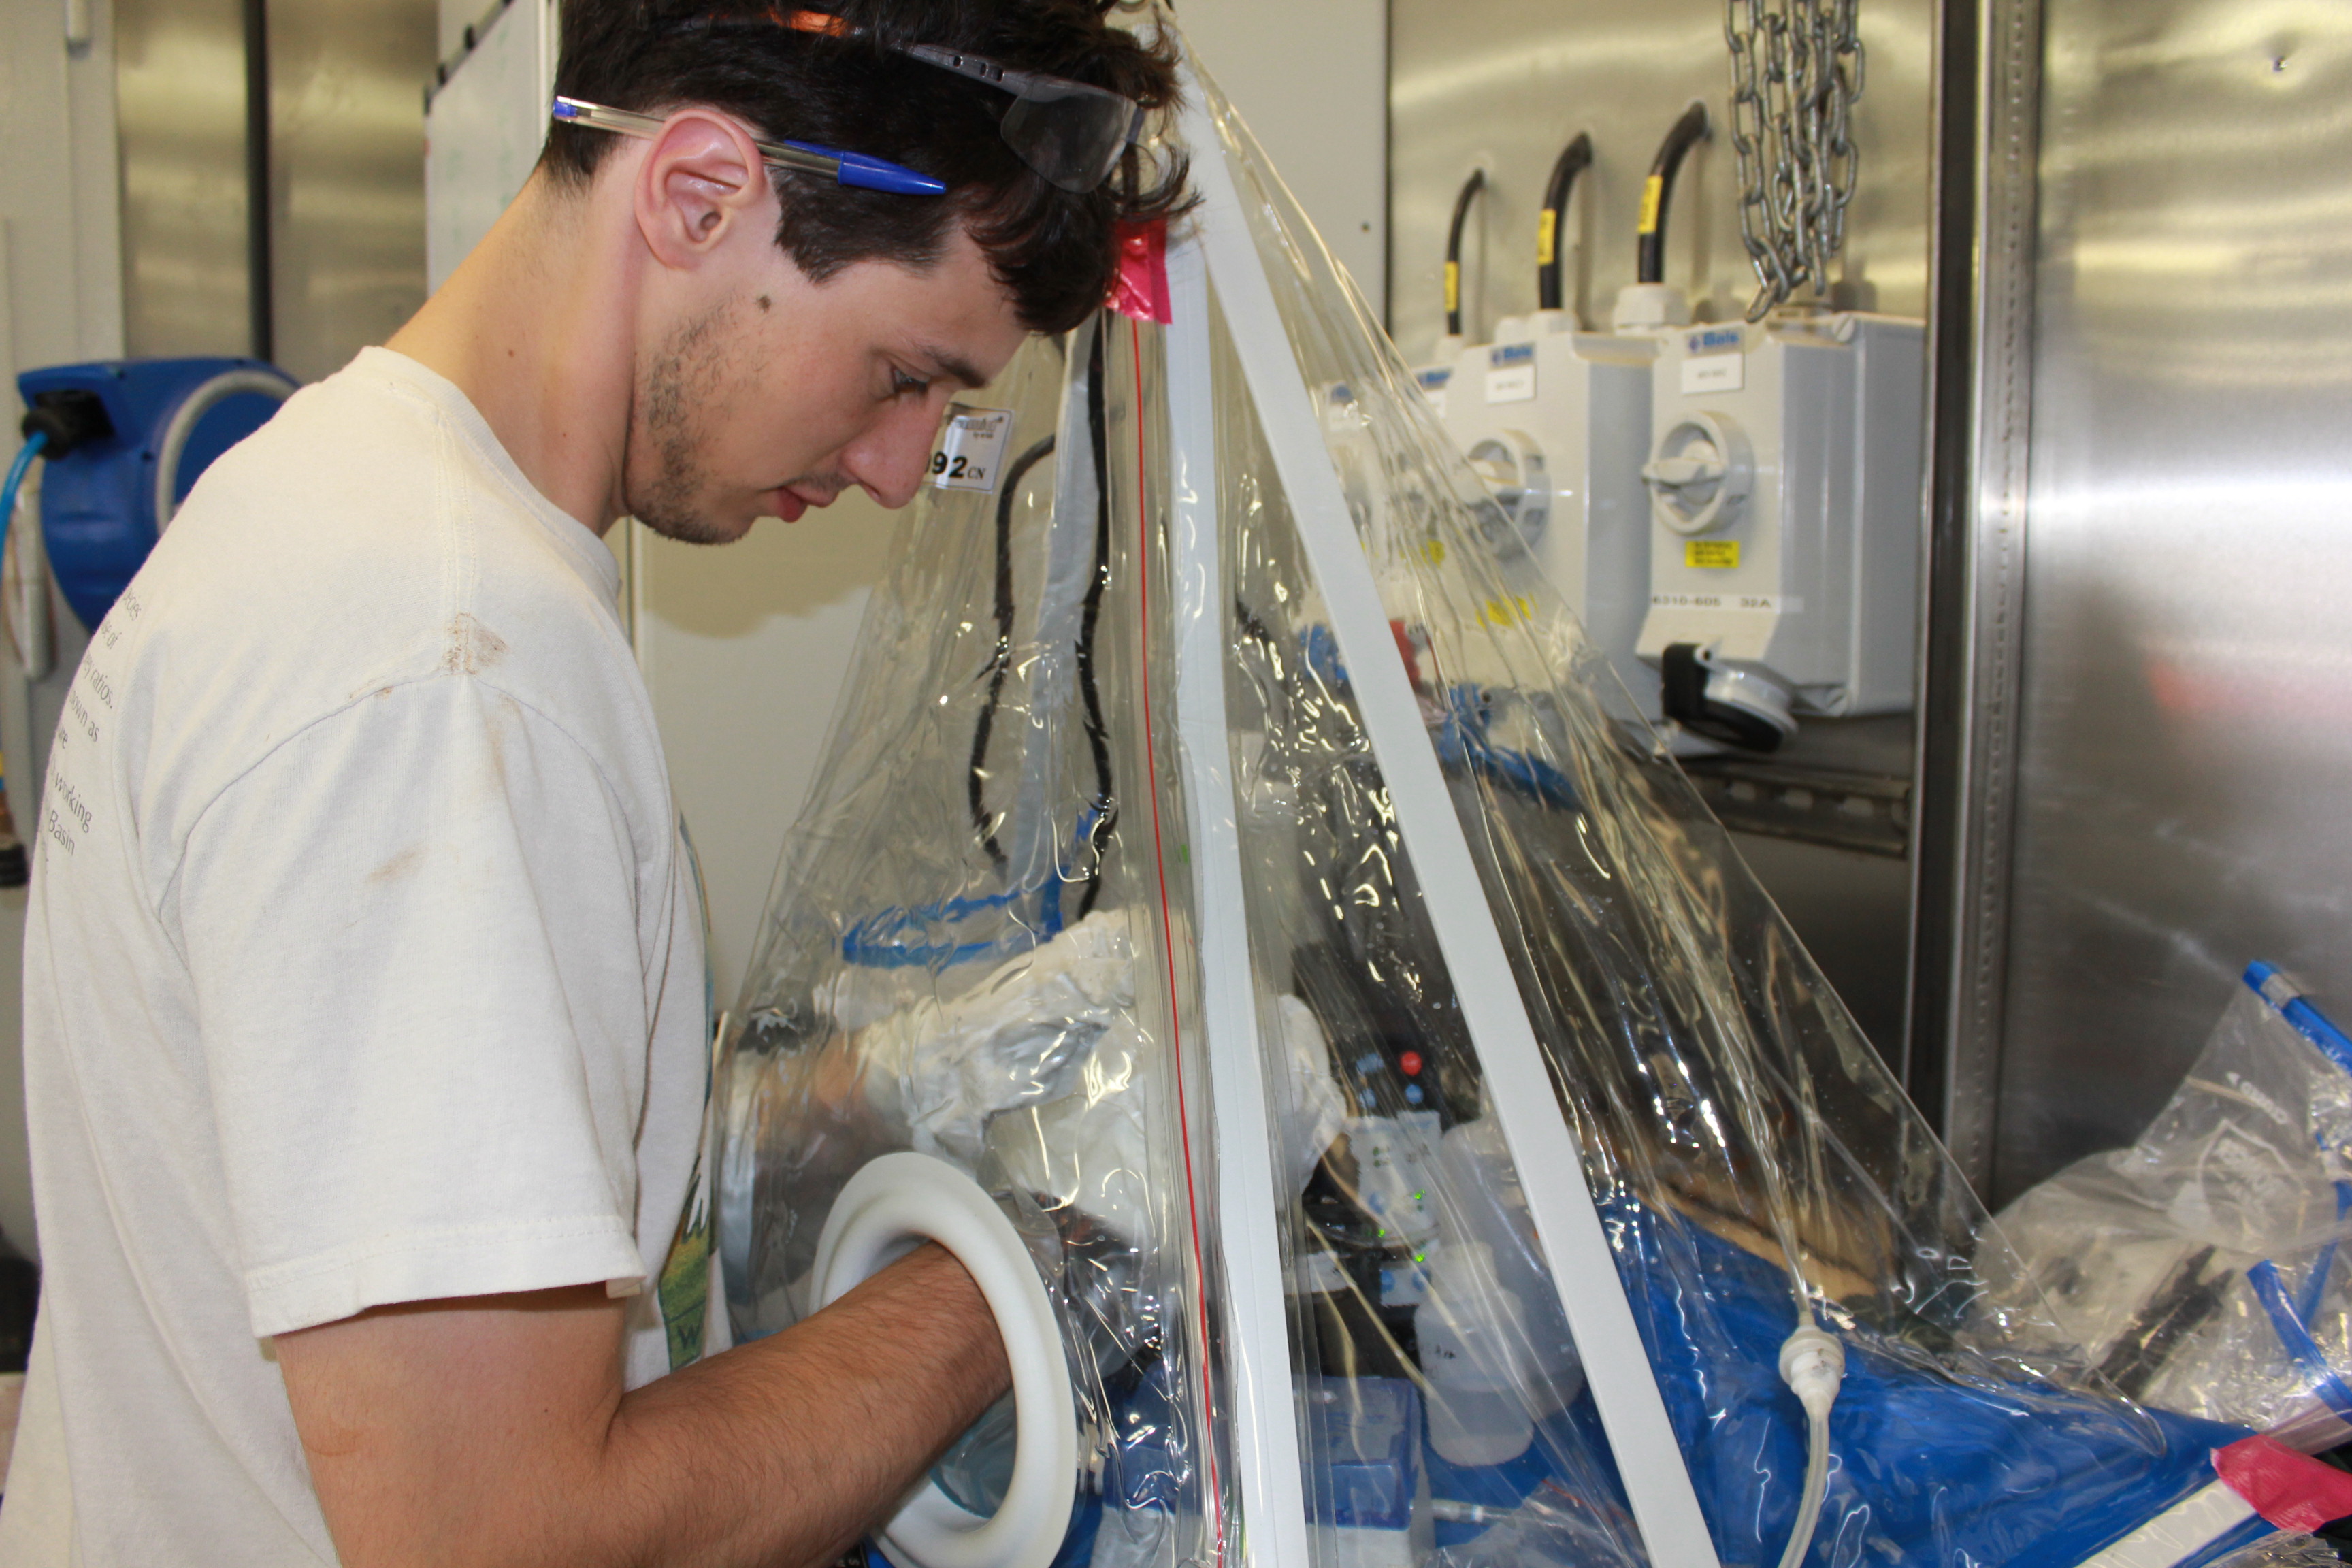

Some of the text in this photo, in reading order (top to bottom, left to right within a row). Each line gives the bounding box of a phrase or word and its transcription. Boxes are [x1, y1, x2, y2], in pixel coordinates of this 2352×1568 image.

[88, 720, 100, 743] as
[54, 772, 93, 834] working
[48, 808, 76, 856] Basin
